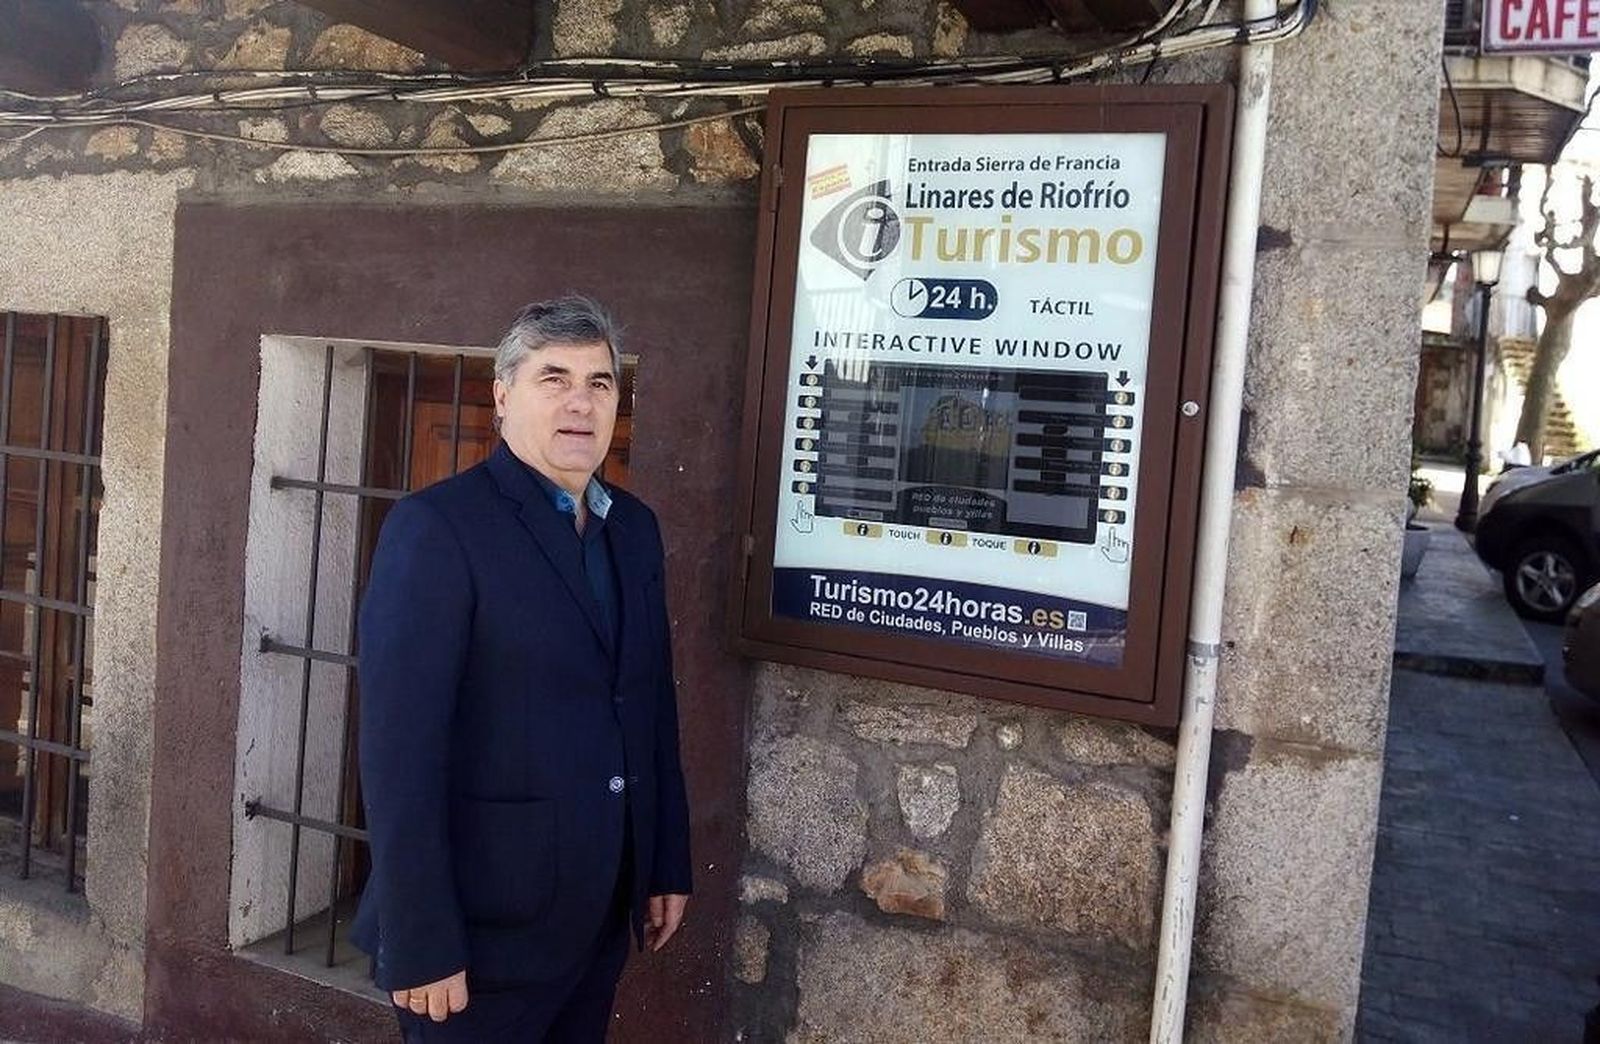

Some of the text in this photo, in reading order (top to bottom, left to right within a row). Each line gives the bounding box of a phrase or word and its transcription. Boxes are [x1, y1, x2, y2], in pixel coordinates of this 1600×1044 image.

[908, 154, 1121, 172] Entrada Sierra de Francia
[905, 180, 1130, 209] Linares de Riofrío
[904, 214, 1144, 264] Turismo
[930, 286, 993, 310] 24 h.
[1030, 297, 1094, 316] TÁCTIL
[813, 330, 1123, 361] INTERACTIVE WINDOW
[889, 529, 921, 541] TOUCH
[972, 538, 1007, 551] TOQUE
[810, 574, 1065, 630] Turismo24horas.es
[810, 601, 1084, 653] RED de Ciudades, Pueblos y Villas
